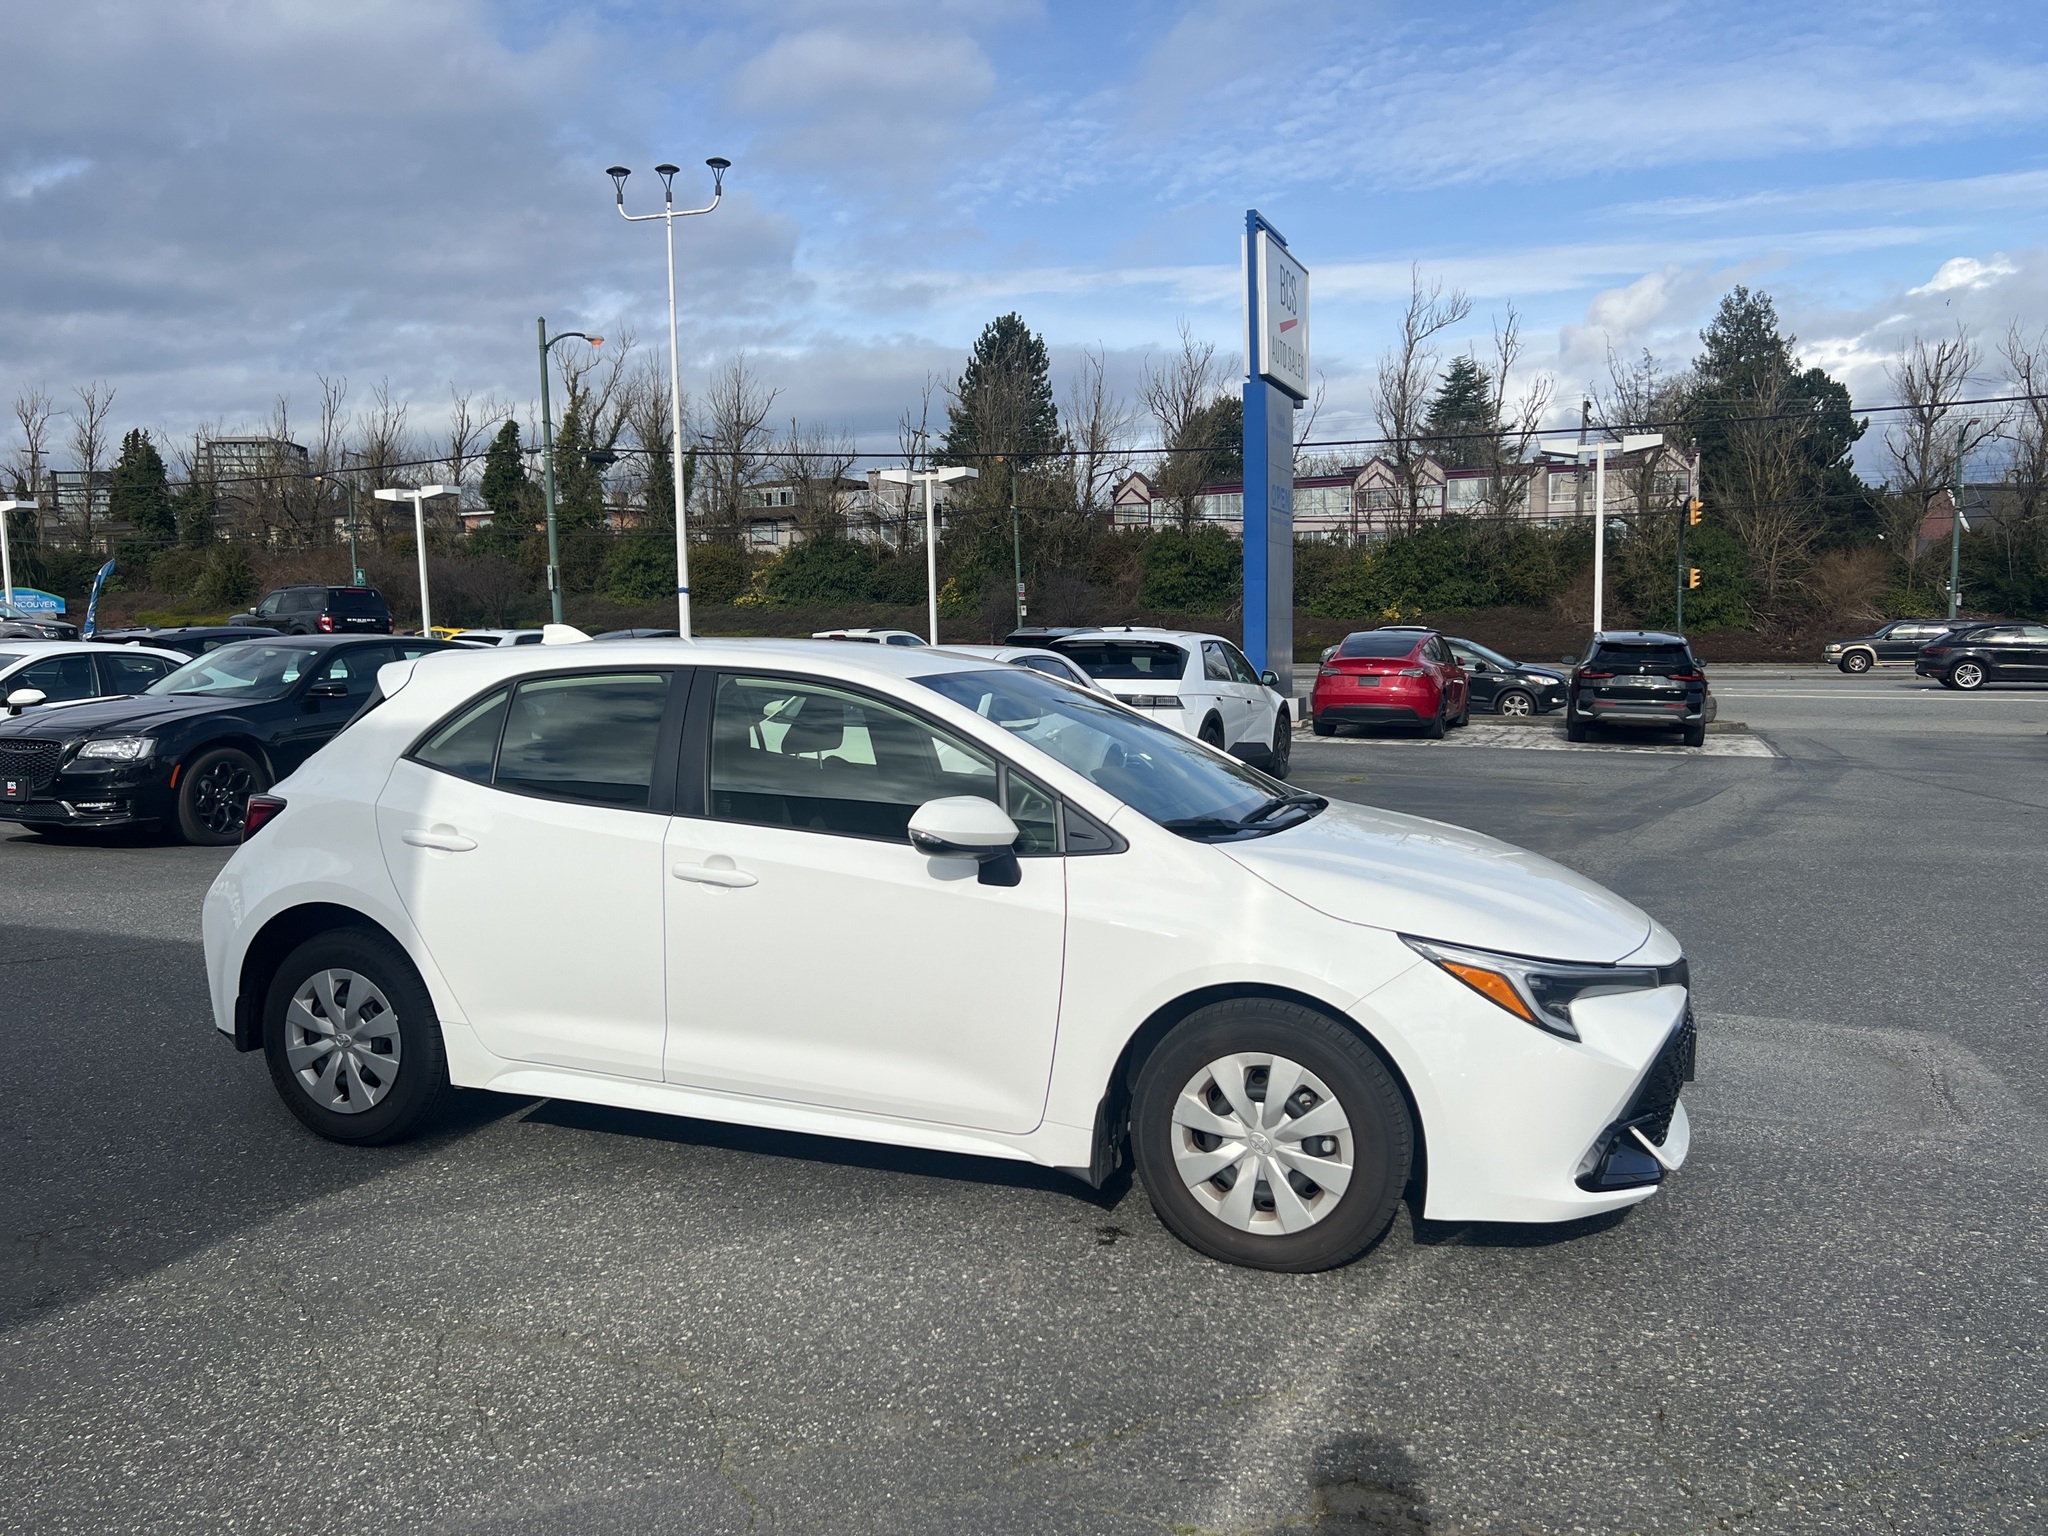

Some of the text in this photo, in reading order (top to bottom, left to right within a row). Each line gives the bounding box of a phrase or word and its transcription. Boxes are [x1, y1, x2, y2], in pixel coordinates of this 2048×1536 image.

[1280, 264, 1297, 316] BCS
[1272, 335, 1304, 380] AUTO SALES
[1271, 484, 1290, 510] OPEN
